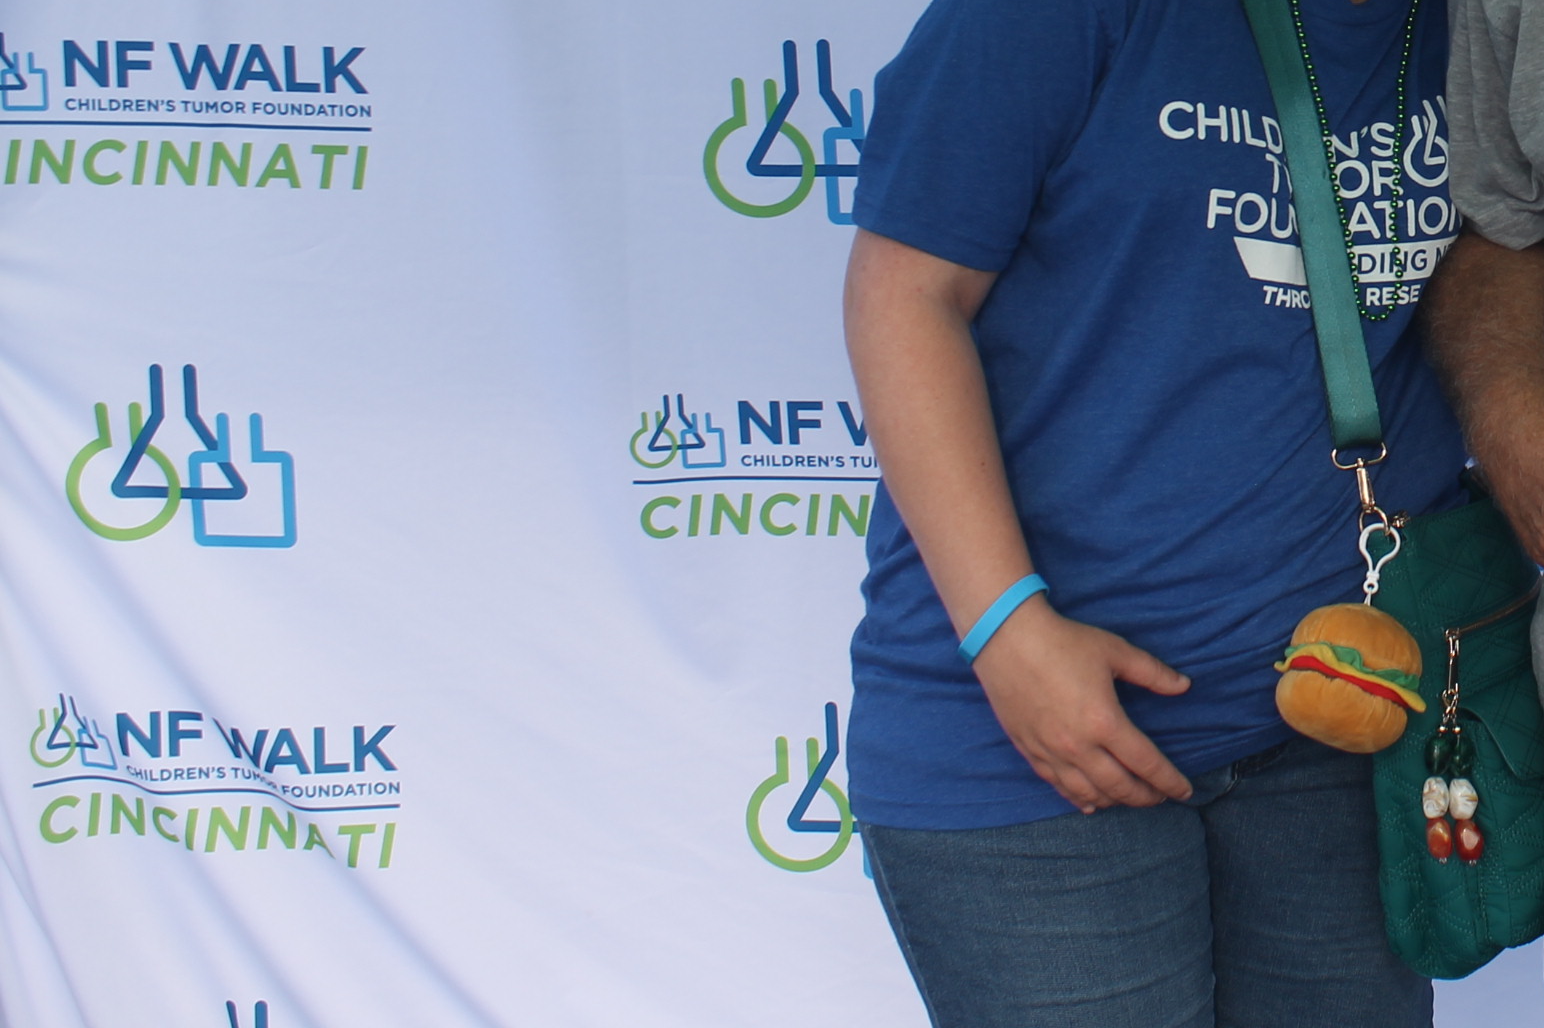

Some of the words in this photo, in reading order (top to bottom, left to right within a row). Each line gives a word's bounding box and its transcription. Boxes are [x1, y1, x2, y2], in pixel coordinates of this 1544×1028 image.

[63, 40, 154, 88] NF
[168, 42, 368, 94] WALK
[65, 98, 176, 112] CHILDREN'S
[181, 101, 245, 113] TUMOR
[252, 102, 371, 117] FOUNDATION
[1158, 100, 1396, 158] CHILDN'S
[4, 139, 368, 190] INCINNATI
[1357, 248, 1427, 274] DING
[1262, 284, 1311, 309] THRO
[738, 401, 823, 445] NF
[741, 455, 845, 467] CHILDREN'S
[641, 493, 870, 539] CINCIN
[116, 711, 203, 758] NF
[212, 718, 397, 775] WALK
[126, 765, 227, 782] CHILDREN'S
[281, 782, 401, 799] FOUNDATION
[40, 792, 397, 868] CINCINNATI
